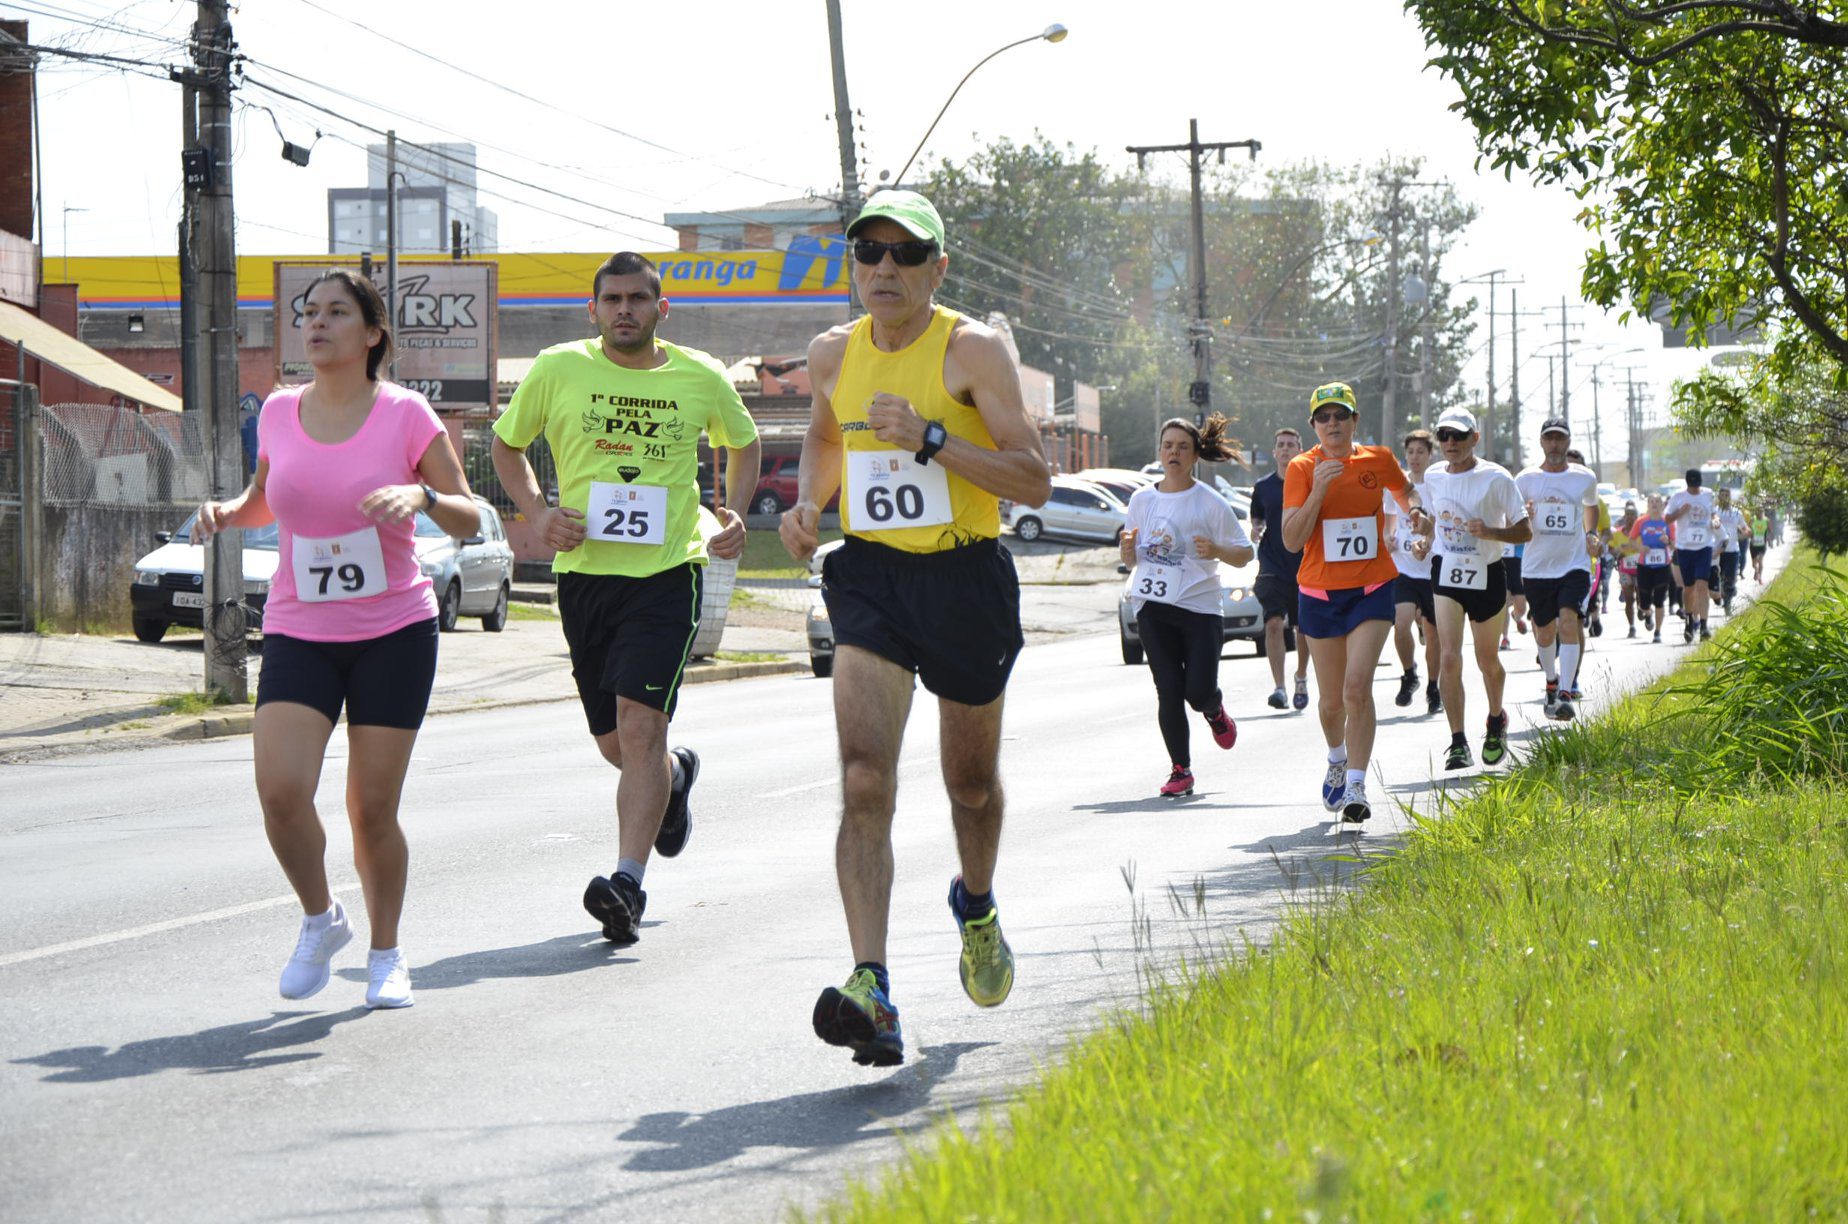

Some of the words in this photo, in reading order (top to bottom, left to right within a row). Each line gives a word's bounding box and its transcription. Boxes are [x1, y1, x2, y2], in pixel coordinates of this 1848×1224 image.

[657, 259, 757, 286] ranga
[609, 396, 678, 410] CORRIDA
[616, 408, 652, 419] PELA
[605, 418, 660, 438] PAZ
[595, 439, 633, 452] Radan
[865, 484, 925, 522] 60
[602, 508, 649, 538] 25
[1545, 515, 1567, 528] 65
[1337, 536, 1368, 557] 70
[1403, 540, 1412, 552] 6
[1691, 533, 1703, 542] 77
[308, 563, 366, 595] 79
[1450, 568, 1477, 585] 87
[1139, 578, 1168, 598] 33
